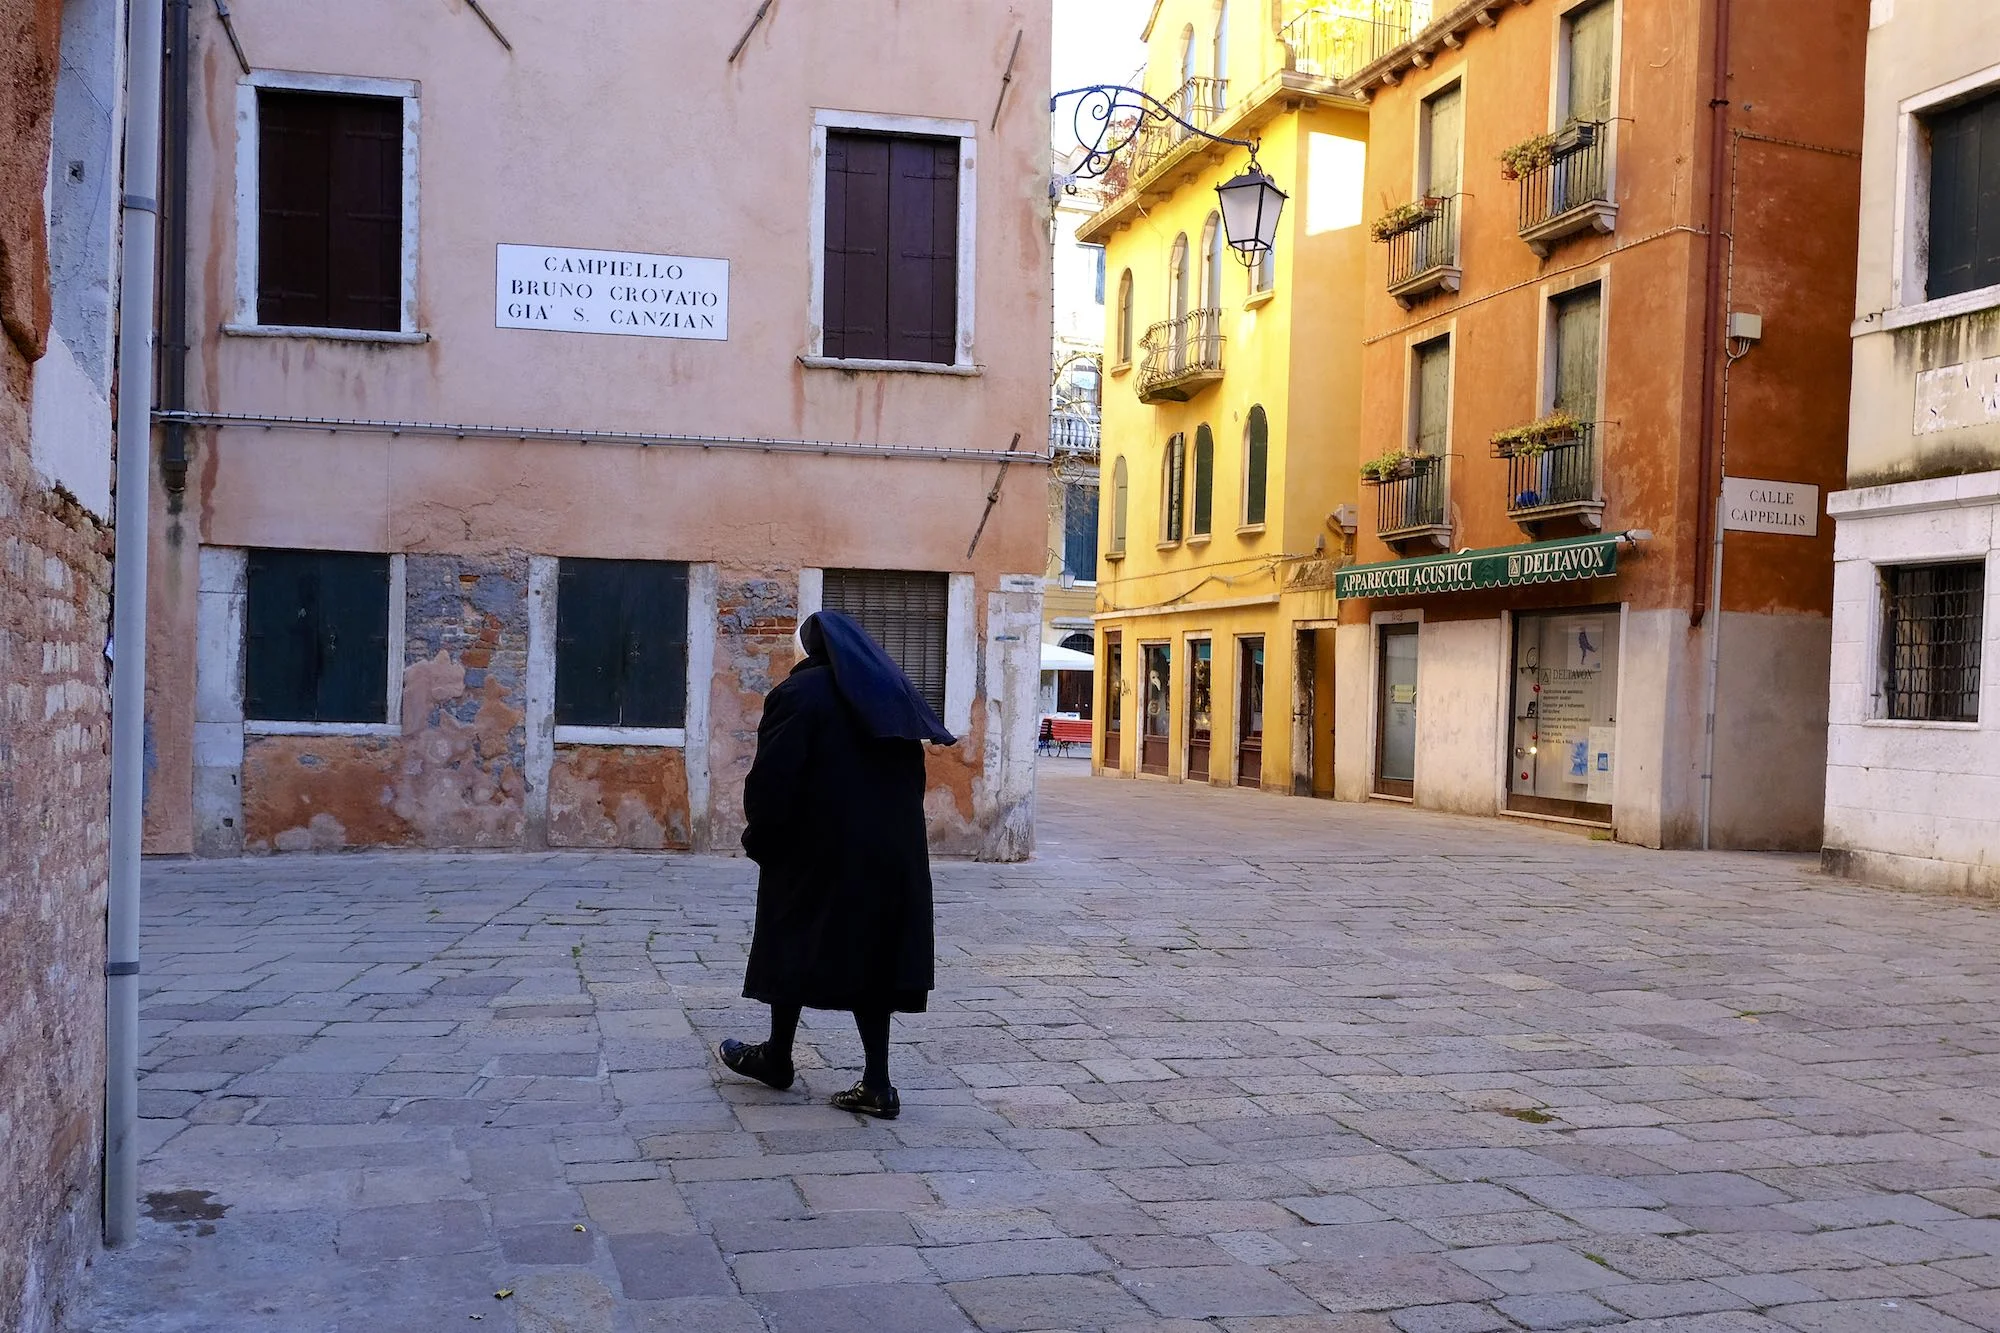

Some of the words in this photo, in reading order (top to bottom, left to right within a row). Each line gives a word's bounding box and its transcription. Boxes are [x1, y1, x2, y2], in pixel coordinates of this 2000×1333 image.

[544, 256, 683, 280] CAMPIELLO
[511, 279, 593, 299] BRUNO
[609, 285, 718, 307] CROVATO
[507, 303, 553, 320] GIA'
[573, 307, 590, 322] S.
[609, 309, 715, 329] CANZIAN
[1749, 489, 1794, 505] CALLE
[1731, 508, 1806, 527] CAPPELLIS
[1341, 568, 1410, 592] APPARECCHI
[1413, 562, 1473, 587] ACUSTICI
[1523, 546, 1605, 575] DELTAVOX
[1553, 668, 1593, 680] DELTAVOX
